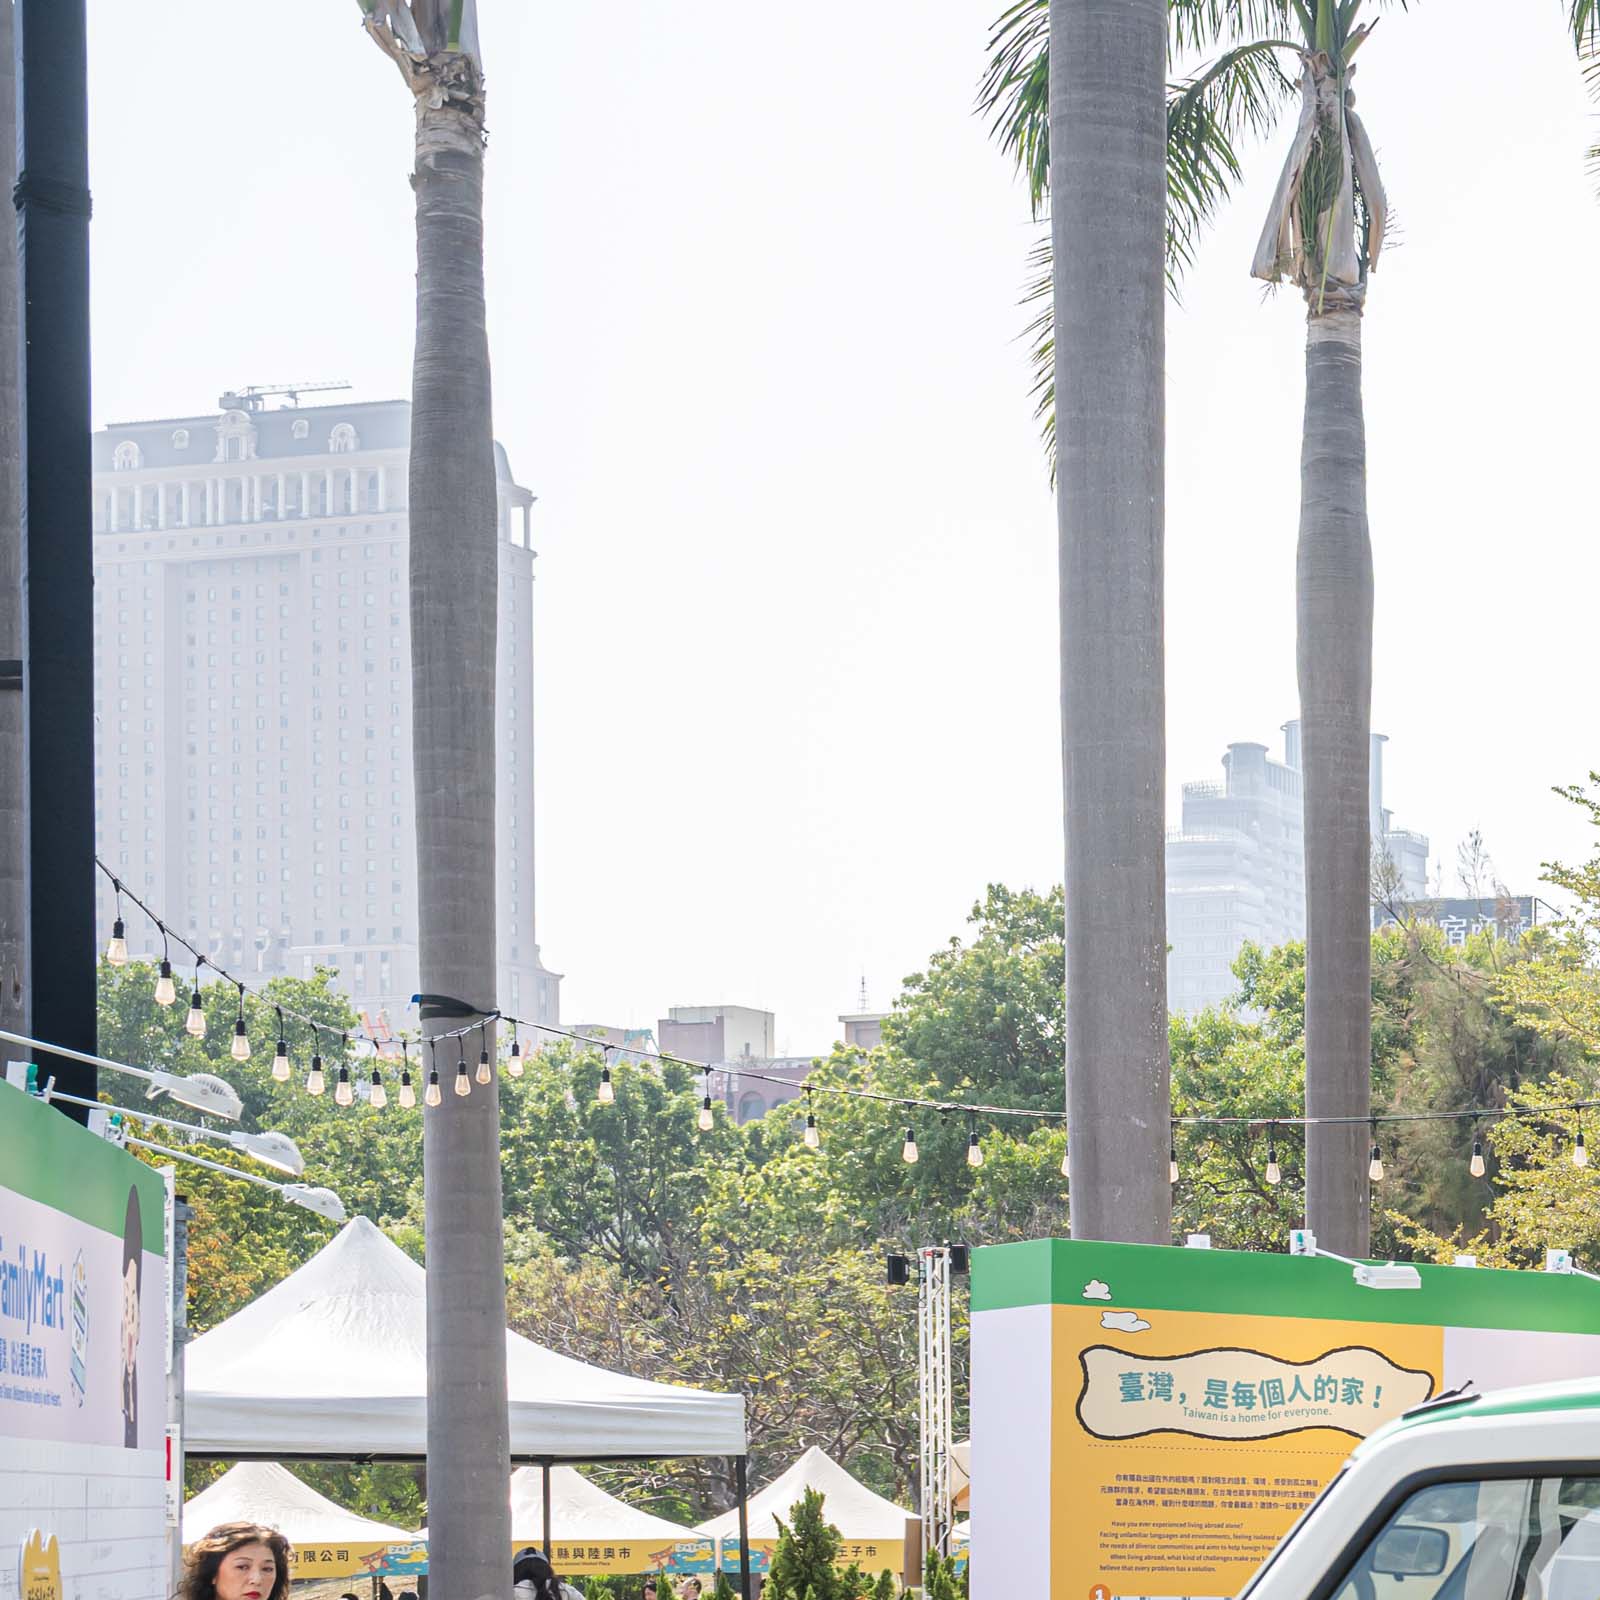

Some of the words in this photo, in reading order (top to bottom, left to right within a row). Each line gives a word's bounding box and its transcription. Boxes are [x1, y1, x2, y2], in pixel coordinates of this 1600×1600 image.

[0, 1236, 64, 1335] amilyMart
[1118, 1371, 1383, 1411] 臺灣，是每個人的家！
[1183, 1406, 1219, 1422] Taiwan
[1220, 1410, 1228, 1422] is
[1230, 1413, 1236, 1422] a
[1238, 1410, 1265, 1423] home
[1267, 1409, 1281, 1421] for
[1283, 1406, 1332, 1419] everyone.
